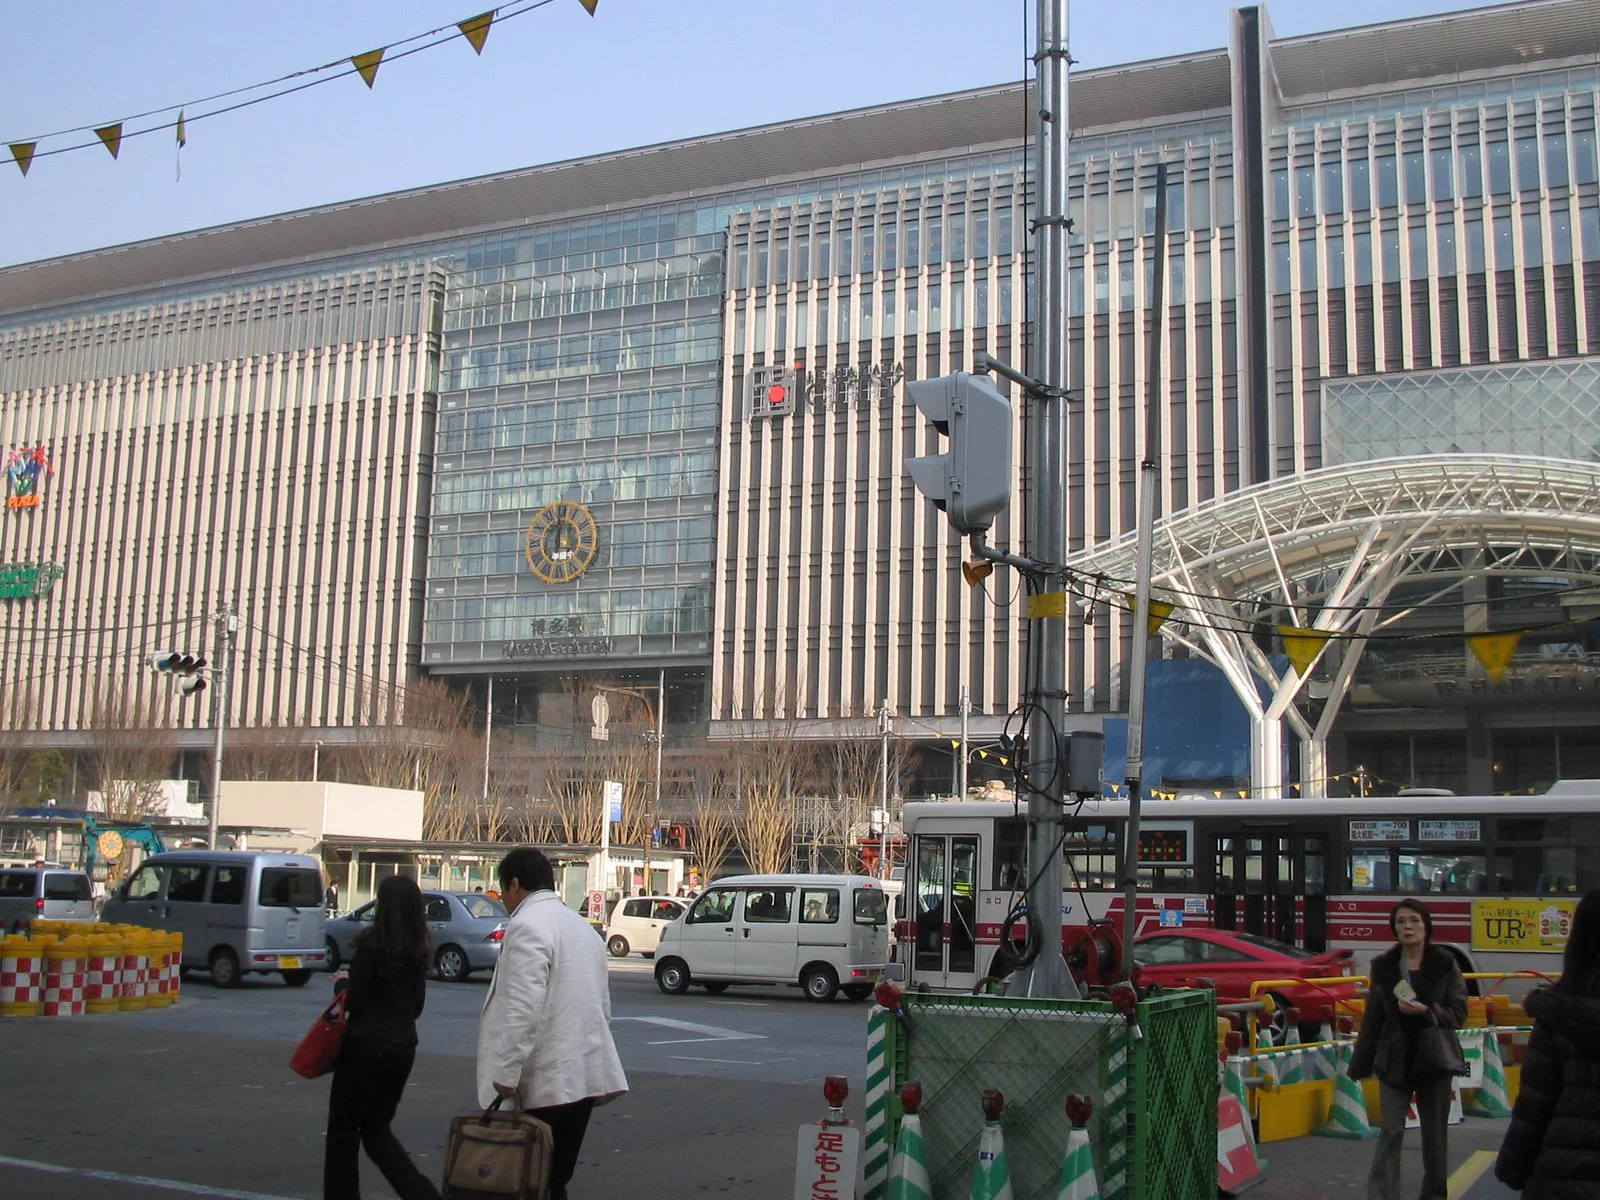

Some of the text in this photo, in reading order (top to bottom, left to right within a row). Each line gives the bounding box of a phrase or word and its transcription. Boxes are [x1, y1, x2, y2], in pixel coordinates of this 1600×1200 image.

[1337, 902, 1357, 911] 入口
[1339, 927, 1373, 937] にしてつ
[1484, 918, 1526, 940] UR
[811, 1132, 844, 1200] 足もと
